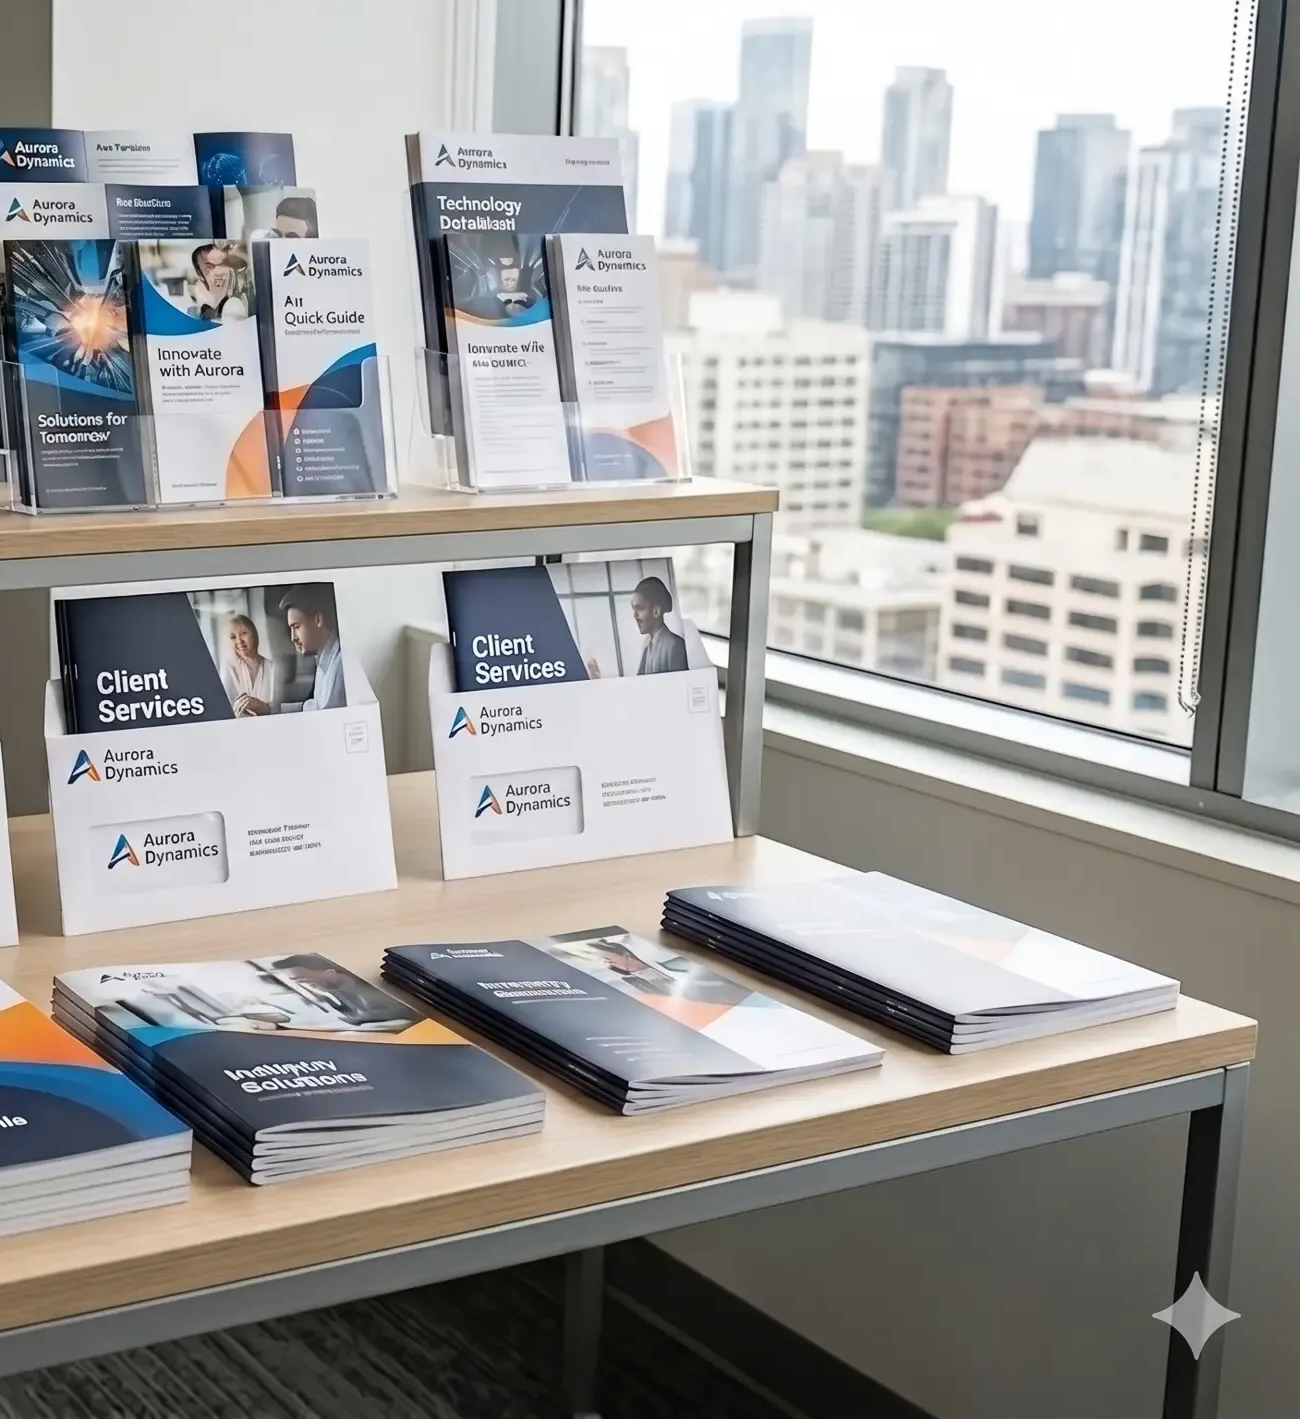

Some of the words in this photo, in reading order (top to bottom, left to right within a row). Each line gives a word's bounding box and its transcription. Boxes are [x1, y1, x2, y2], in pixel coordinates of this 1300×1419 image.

[15, 141, 58, 154] Aurora
[33, 199, 76, 210] Aurora
[437, 195, 522, 216] Technology
[33, 212, 93, 226] Dynamics
[308, 254, 347, 264] Aurora
[598, 249, 632, 259] Aurora
[308, 266, 363, 279] Dynamics
[284, 311, 324, 327] Quick
[326, 310, 365, 324] Guide
[160, 363, 191, 377] with
[194, 363, 244, 376] Aurora
[37, 413, 104, 427] Solutions
[105, 412, 128, 425] for
[472, 633, 535, 659] Client
[475, 658, 566, 684] Services
[96, 668, 169, 695] Client
[98, 694, 205, 723] Services
[480, 706, 523, 718] Aurora
[480, 717, 543, 737] Dynamics
[103, 749, 154, 763] Aurora
[105, 761, 178, 783] Dynamics
[505, 783, 551, 797] Aurora
[506, 795, 571, 816] Dynamics
[143, 831, 196, 848] Aurora
[145, 843, 219, 866] Dynamics
